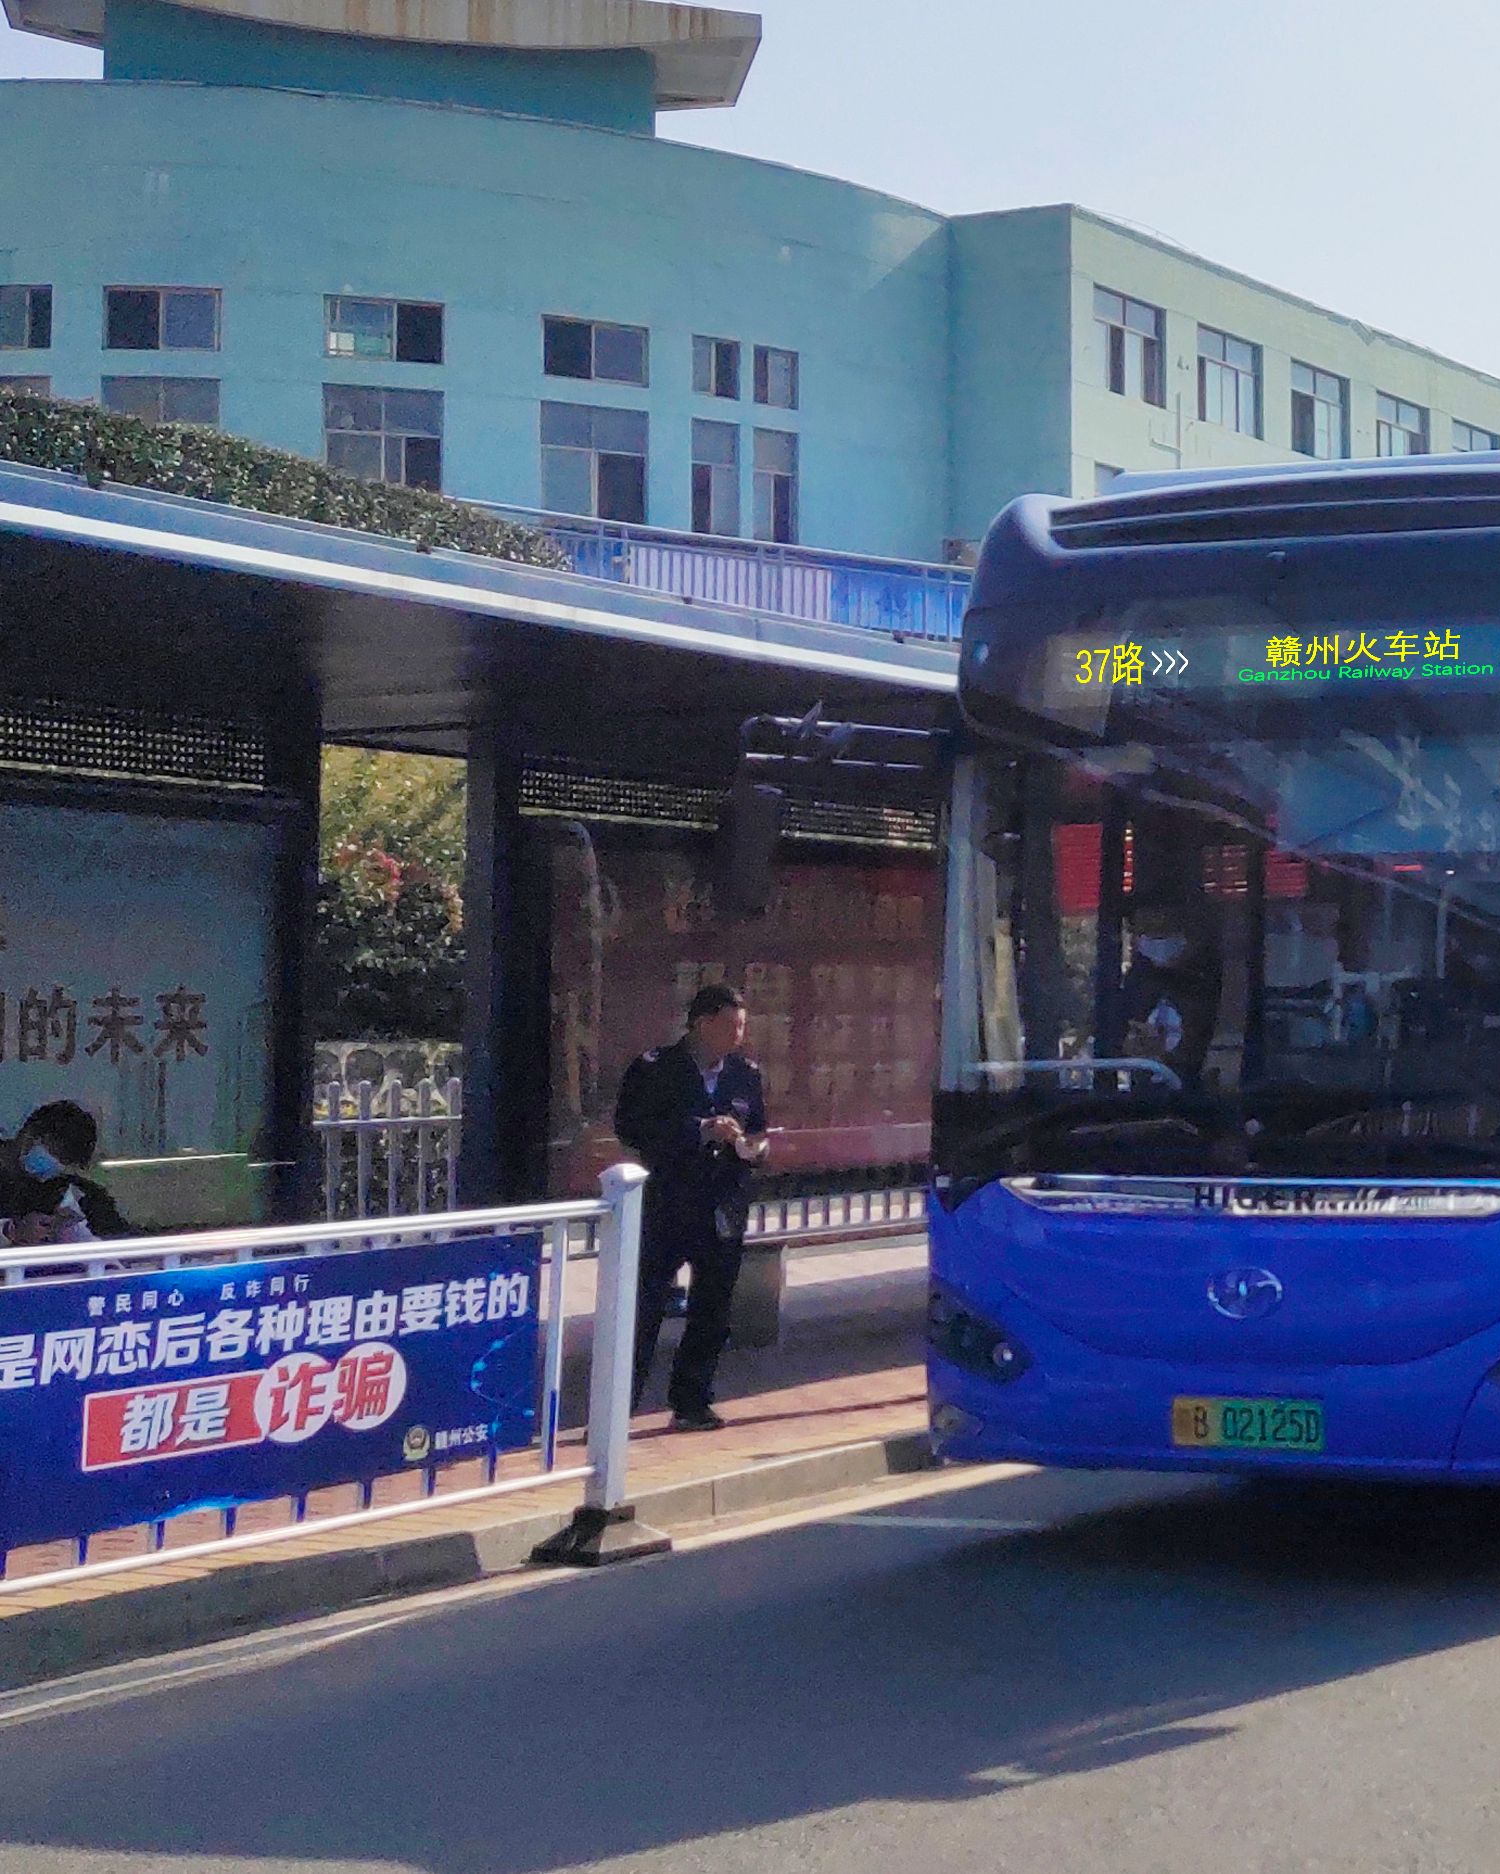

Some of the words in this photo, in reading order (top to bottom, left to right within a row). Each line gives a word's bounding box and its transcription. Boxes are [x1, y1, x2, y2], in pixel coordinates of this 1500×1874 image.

[1075, 641, 1145, 686] 37路
[1266, 628, 1461, 667] 赣州火车站
[1238, 666, 1331, 683] Ganzhou
[1338, 663, 1415, 681] Railway
[1421, 662, 1494, 677] Station
[0, 982, 209, 1065] 的未来
[0, 1273, 529, 1389] 是网恋后各种理由要钱的
